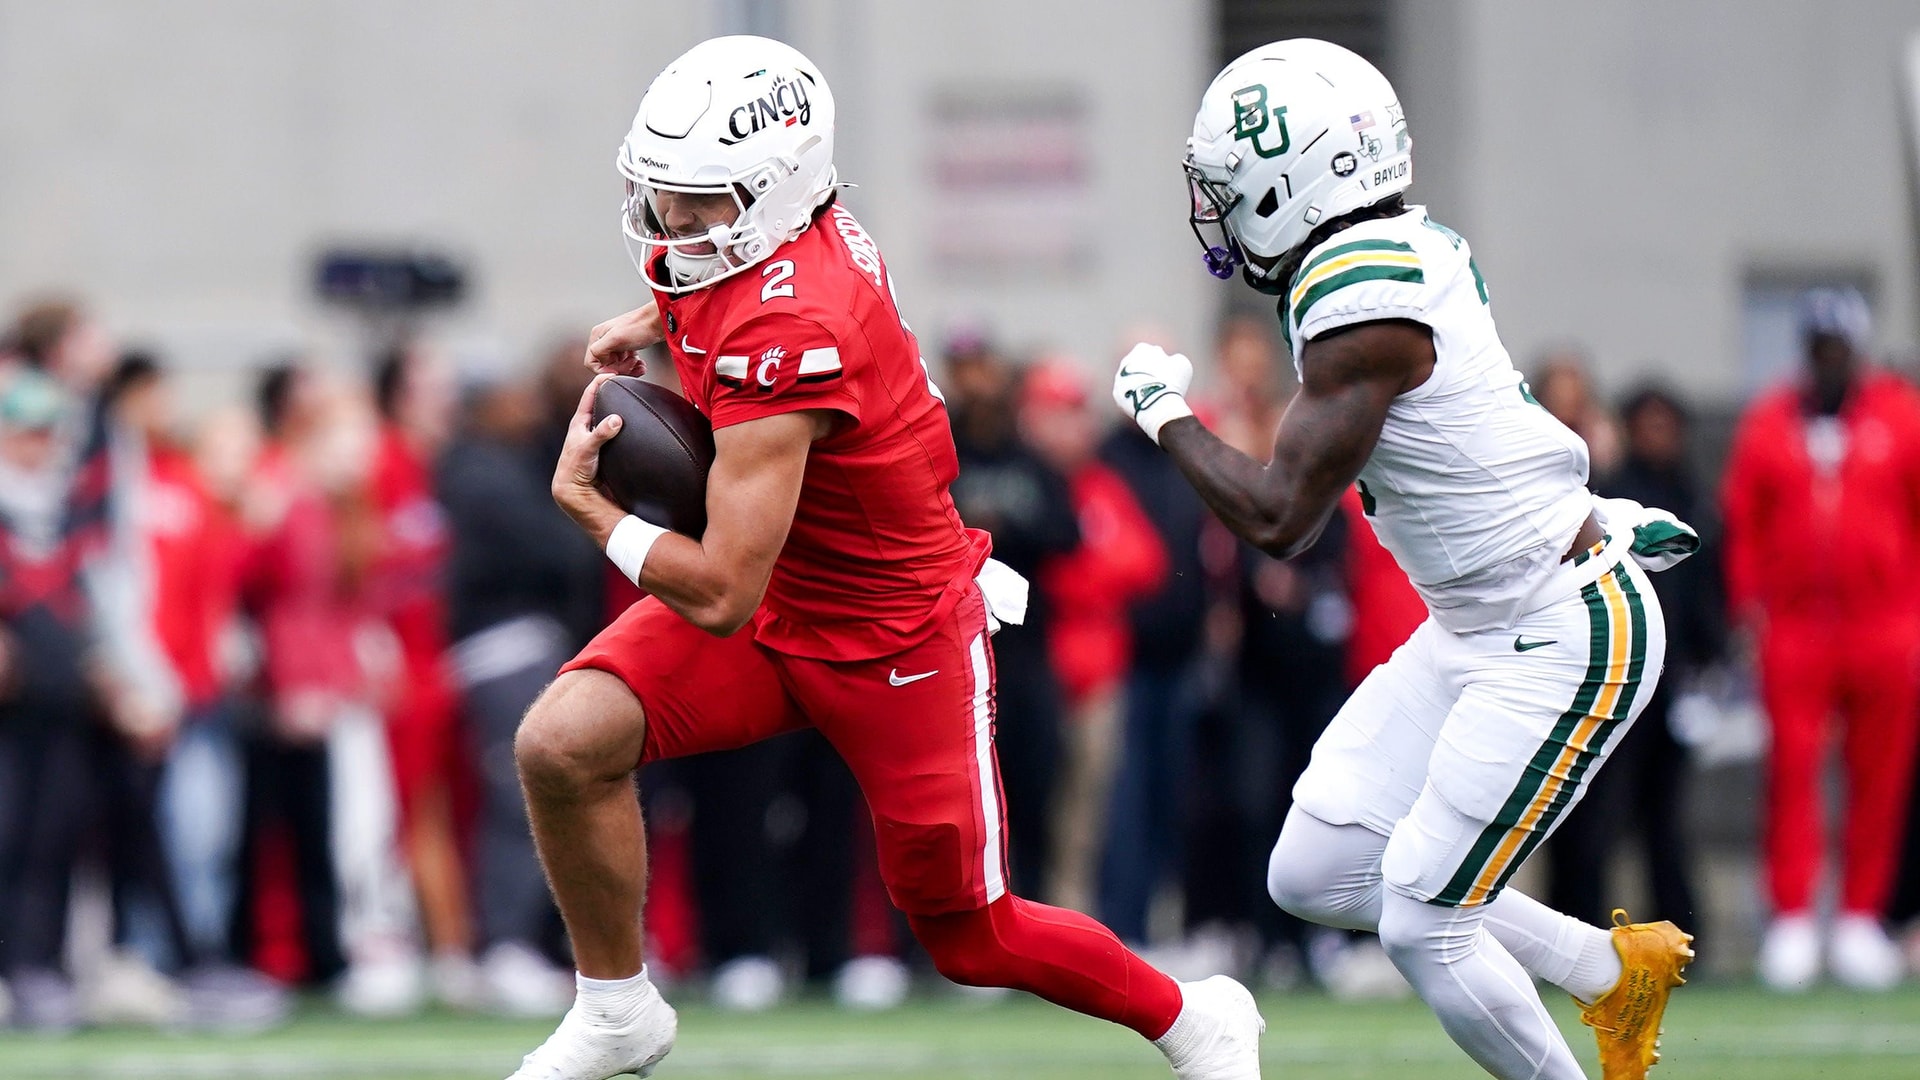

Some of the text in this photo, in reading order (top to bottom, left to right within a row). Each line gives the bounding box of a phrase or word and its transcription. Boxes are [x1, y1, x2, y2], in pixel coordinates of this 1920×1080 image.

[1231, 83, 1290, 159] BU
[1333, 155, 1355, 173] 95
[1374, 161, 1407, 187] BAYLOR
[760, 258, 797, 304] 2
[756, 353, 783, 388] C
